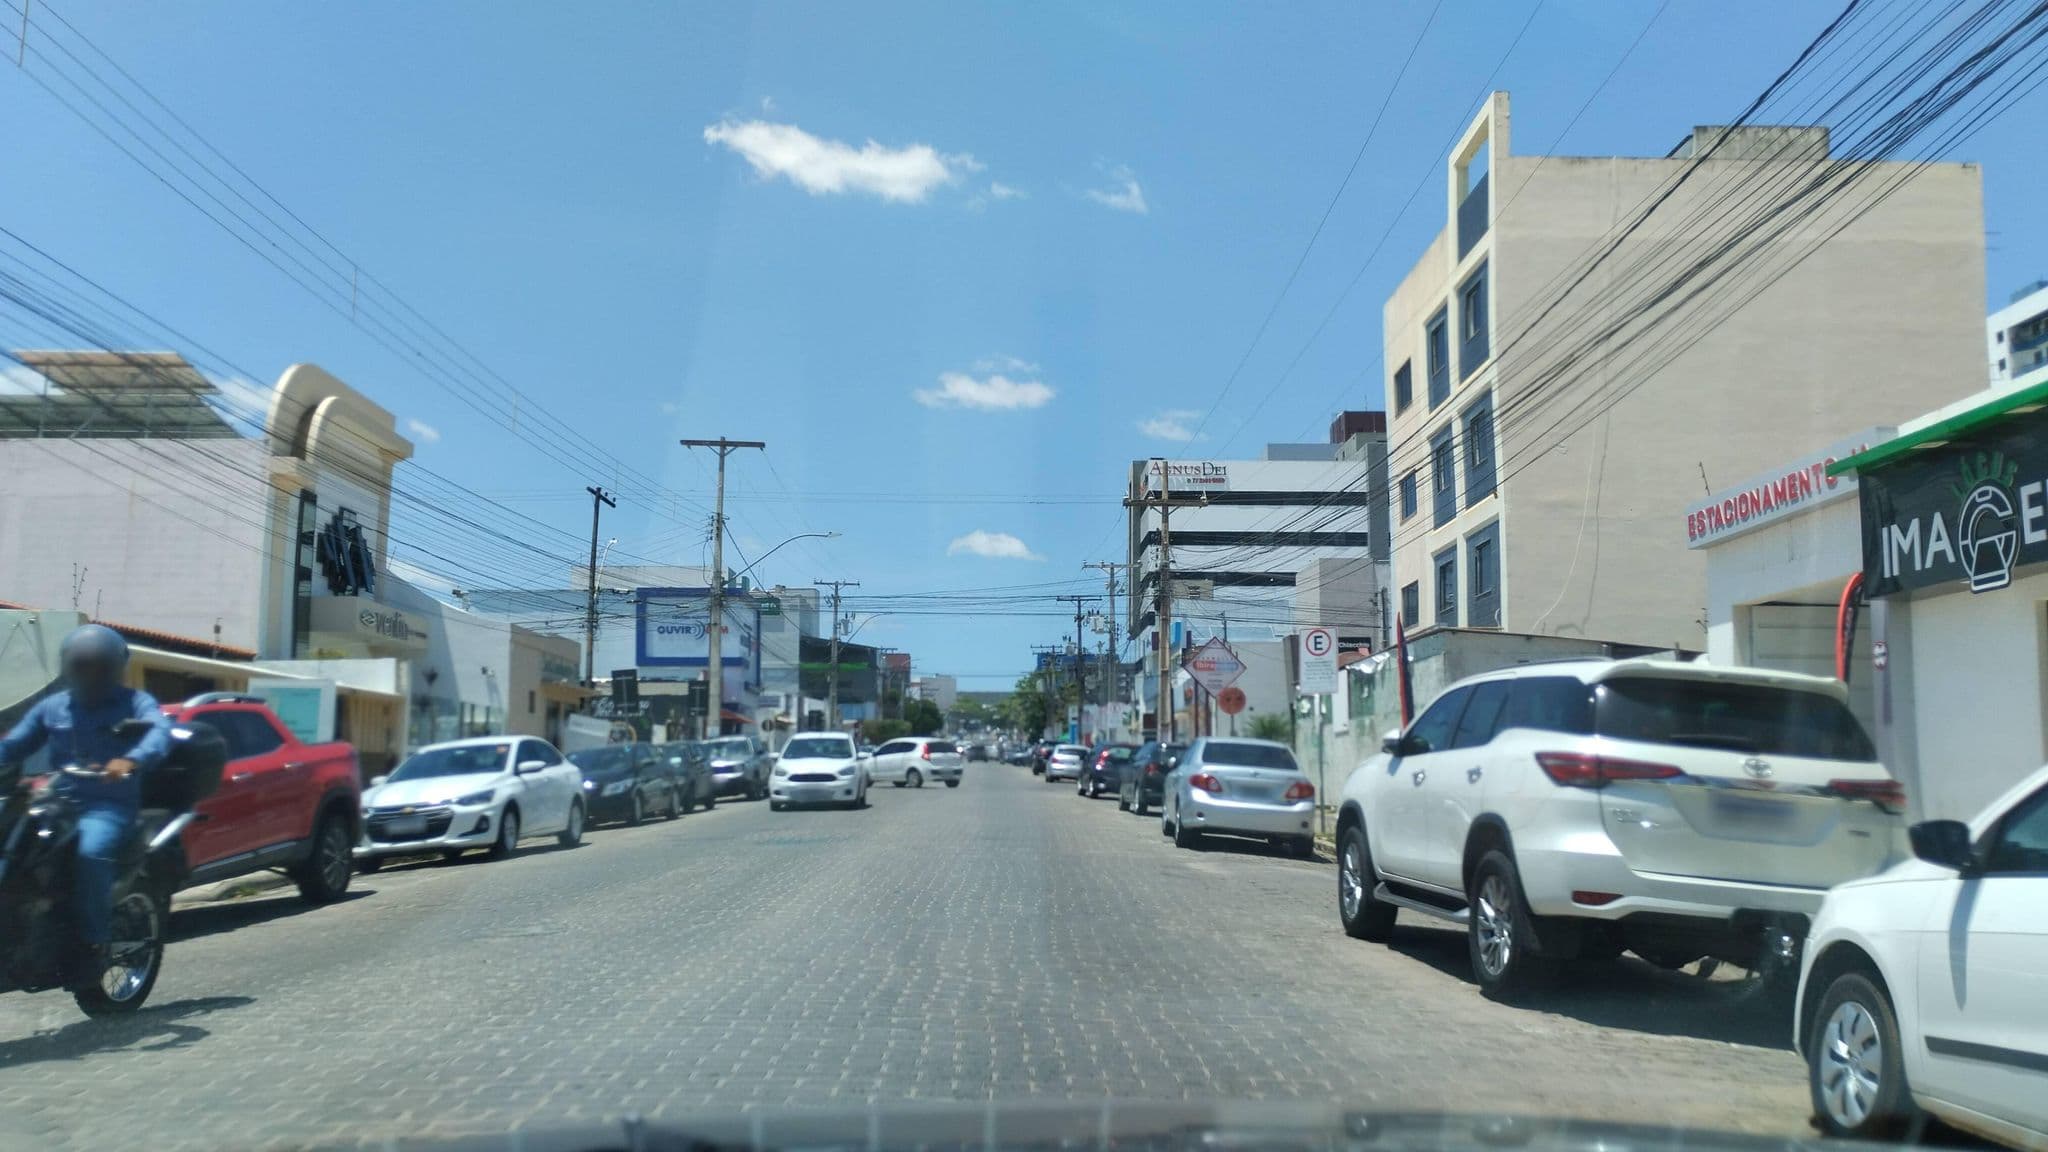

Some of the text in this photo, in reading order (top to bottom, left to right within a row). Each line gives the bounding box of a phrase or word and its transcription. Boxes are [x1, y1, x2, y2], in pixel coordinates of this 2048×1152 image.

[1882, 479, 2048, 592] IMAGE
[657, 625, 691, 634] OUVIR
[1314, 635, 1323, 651] E
